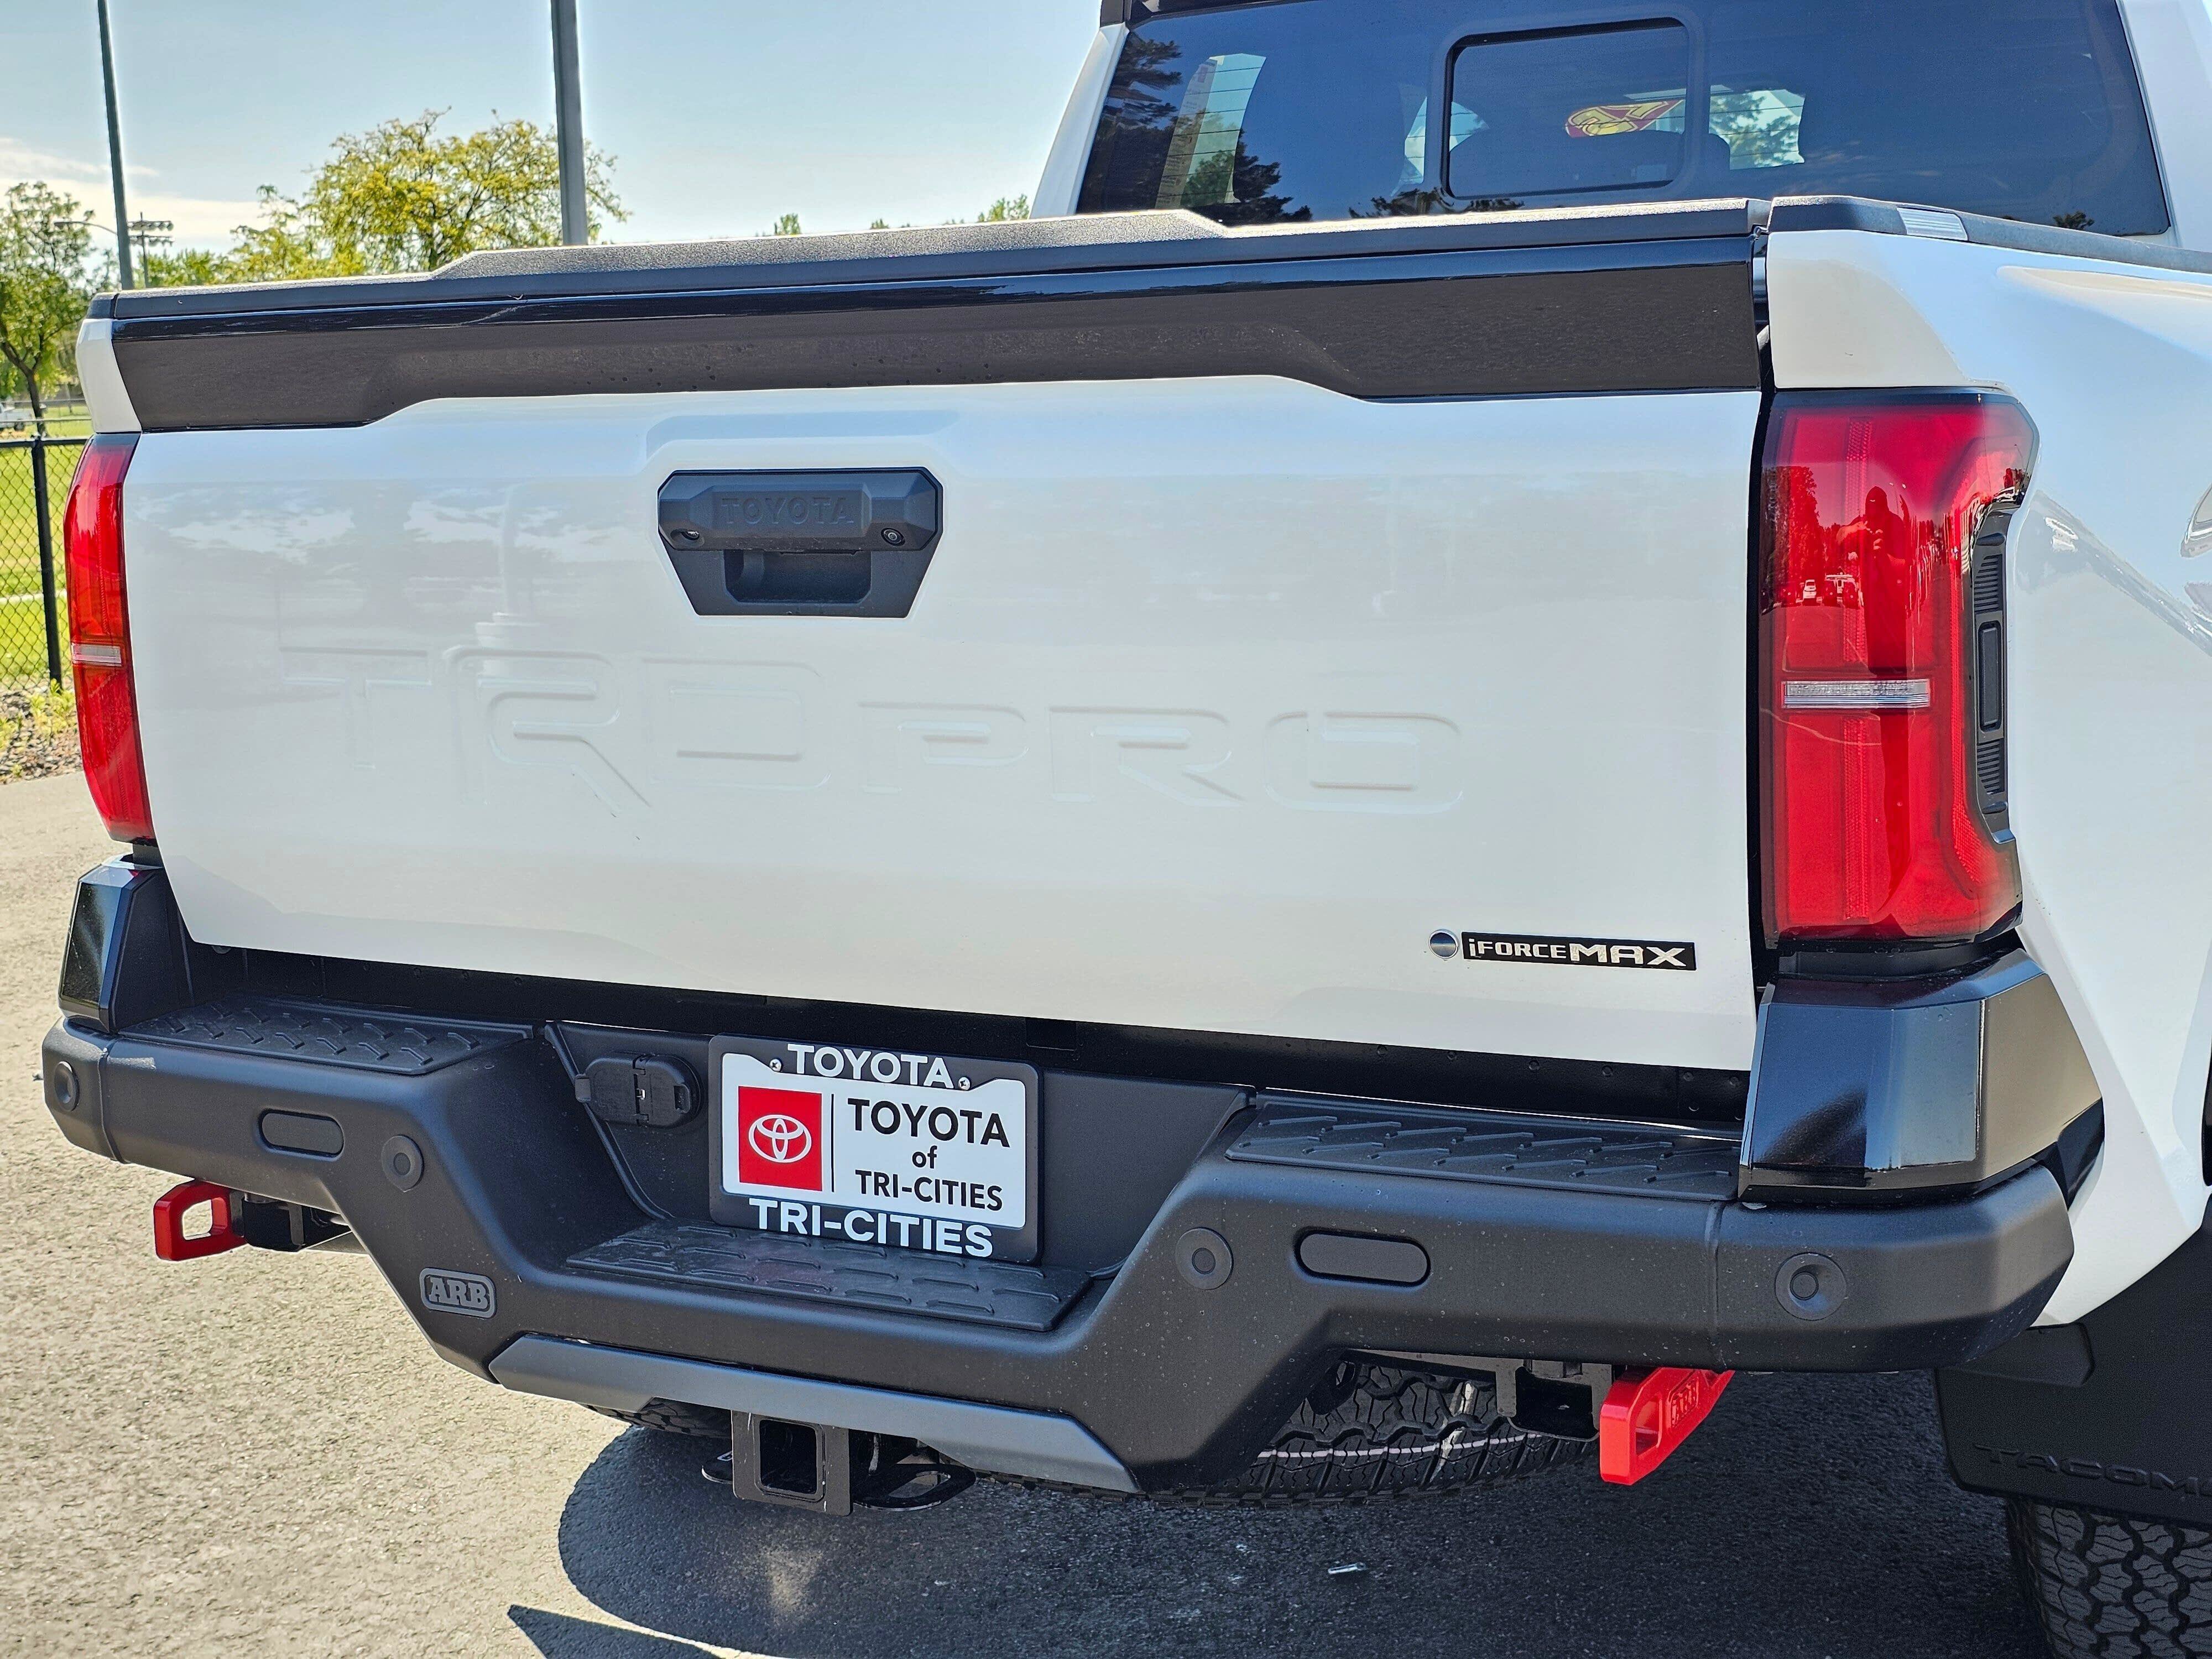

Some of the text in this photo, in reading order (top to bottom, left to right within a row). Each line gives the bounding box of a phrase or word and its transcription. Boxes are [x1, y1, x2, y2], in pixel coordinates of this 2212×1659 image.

[721, 498, 854, 525] TOYOTA
[278, 644, 1463, 817] TRD PRO
[787, 1043, 954, 1089] TOYOTA
[847, 1098, 1010, 1148] TOYOTA
[912, 1145, 937, 1169] of
[855, 1169, 1003, 1211] TRI-CITIES
[749, 1198, 993, 1258] TRI-CITIES
[429, 1276, 488, 1310] ARB
